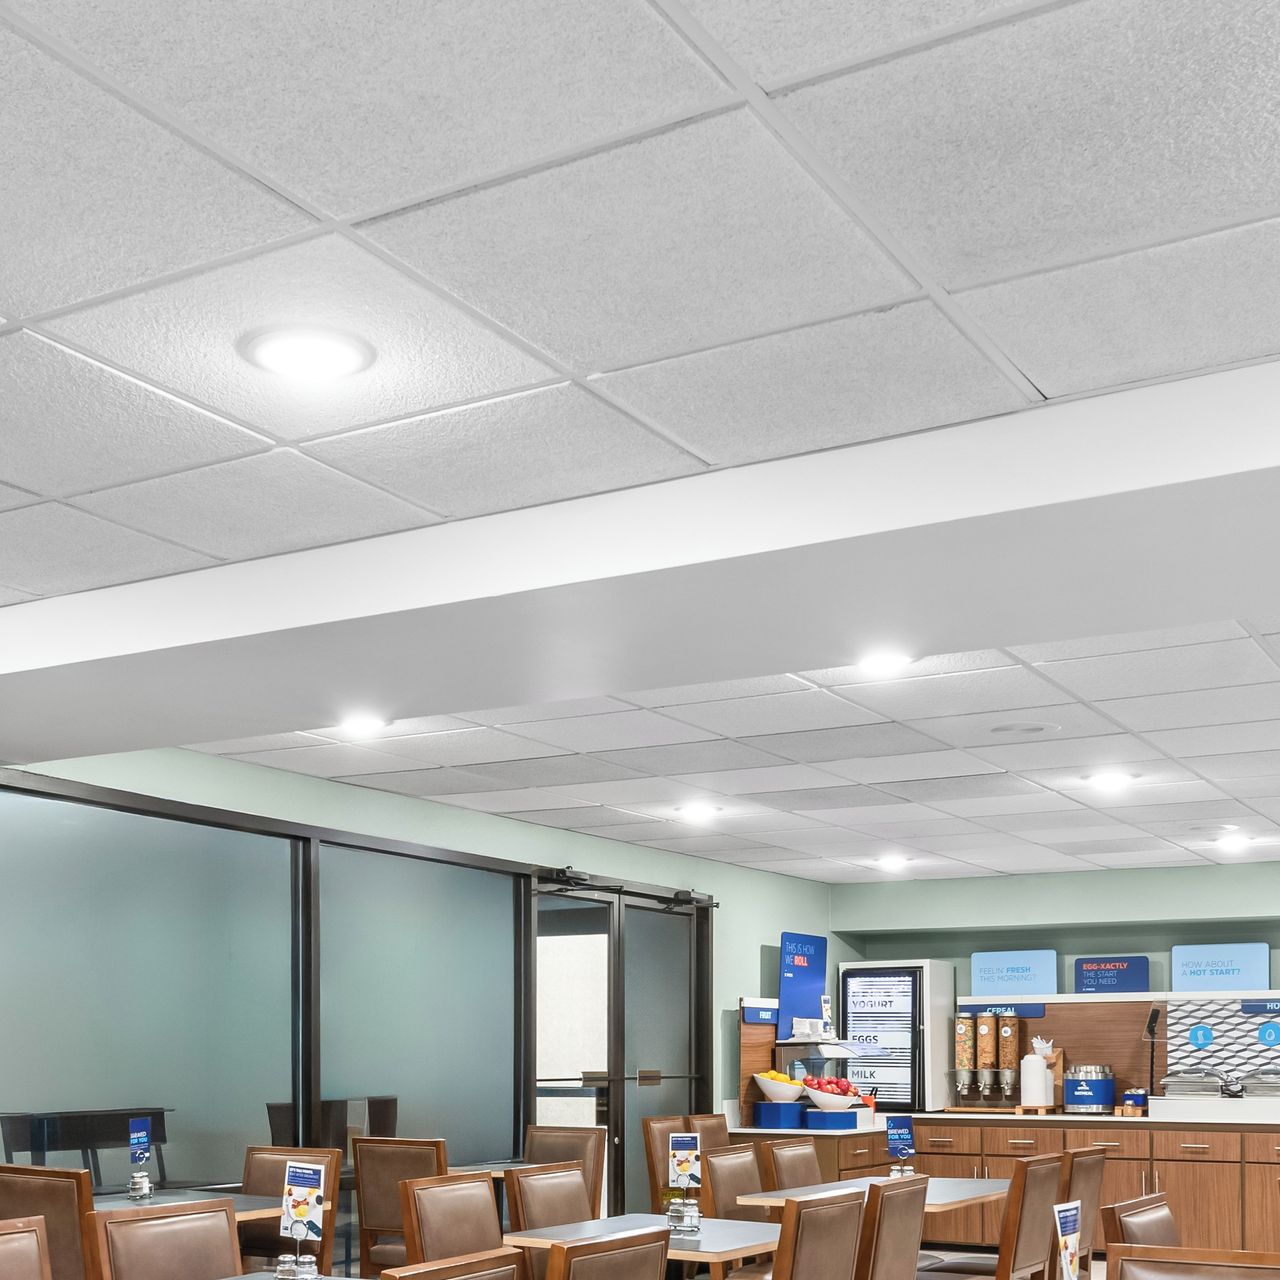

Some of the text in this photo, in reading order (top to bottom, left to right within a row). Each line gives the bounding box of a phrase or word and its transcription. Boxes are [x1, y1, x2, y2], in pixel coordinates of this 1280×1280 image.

[786, 942, 796, 954] THIS
[803, 945, 815, 955] HOW
[785, 955, 808, 967] WE ROLL
[1181, 959, 1234, 969] HOW ABOUT
[1006, 966, 1031, 974] FRESH
[1082, 962, 1128, 970] EGG-XACTLY
[1098, 970, 1118, 978] START
[1181, 969, 1188, 977] A
[1209, 968, 1241, 976] START?
[980, 975, 996, 983] THIS
[852, 1000, 894, 1008] YOGURT
[759, 1011, 772, 1020] FRUIT
[852, 1035, 879, 1044] EGGS
[851, 1070, 876, 1079] MILK
